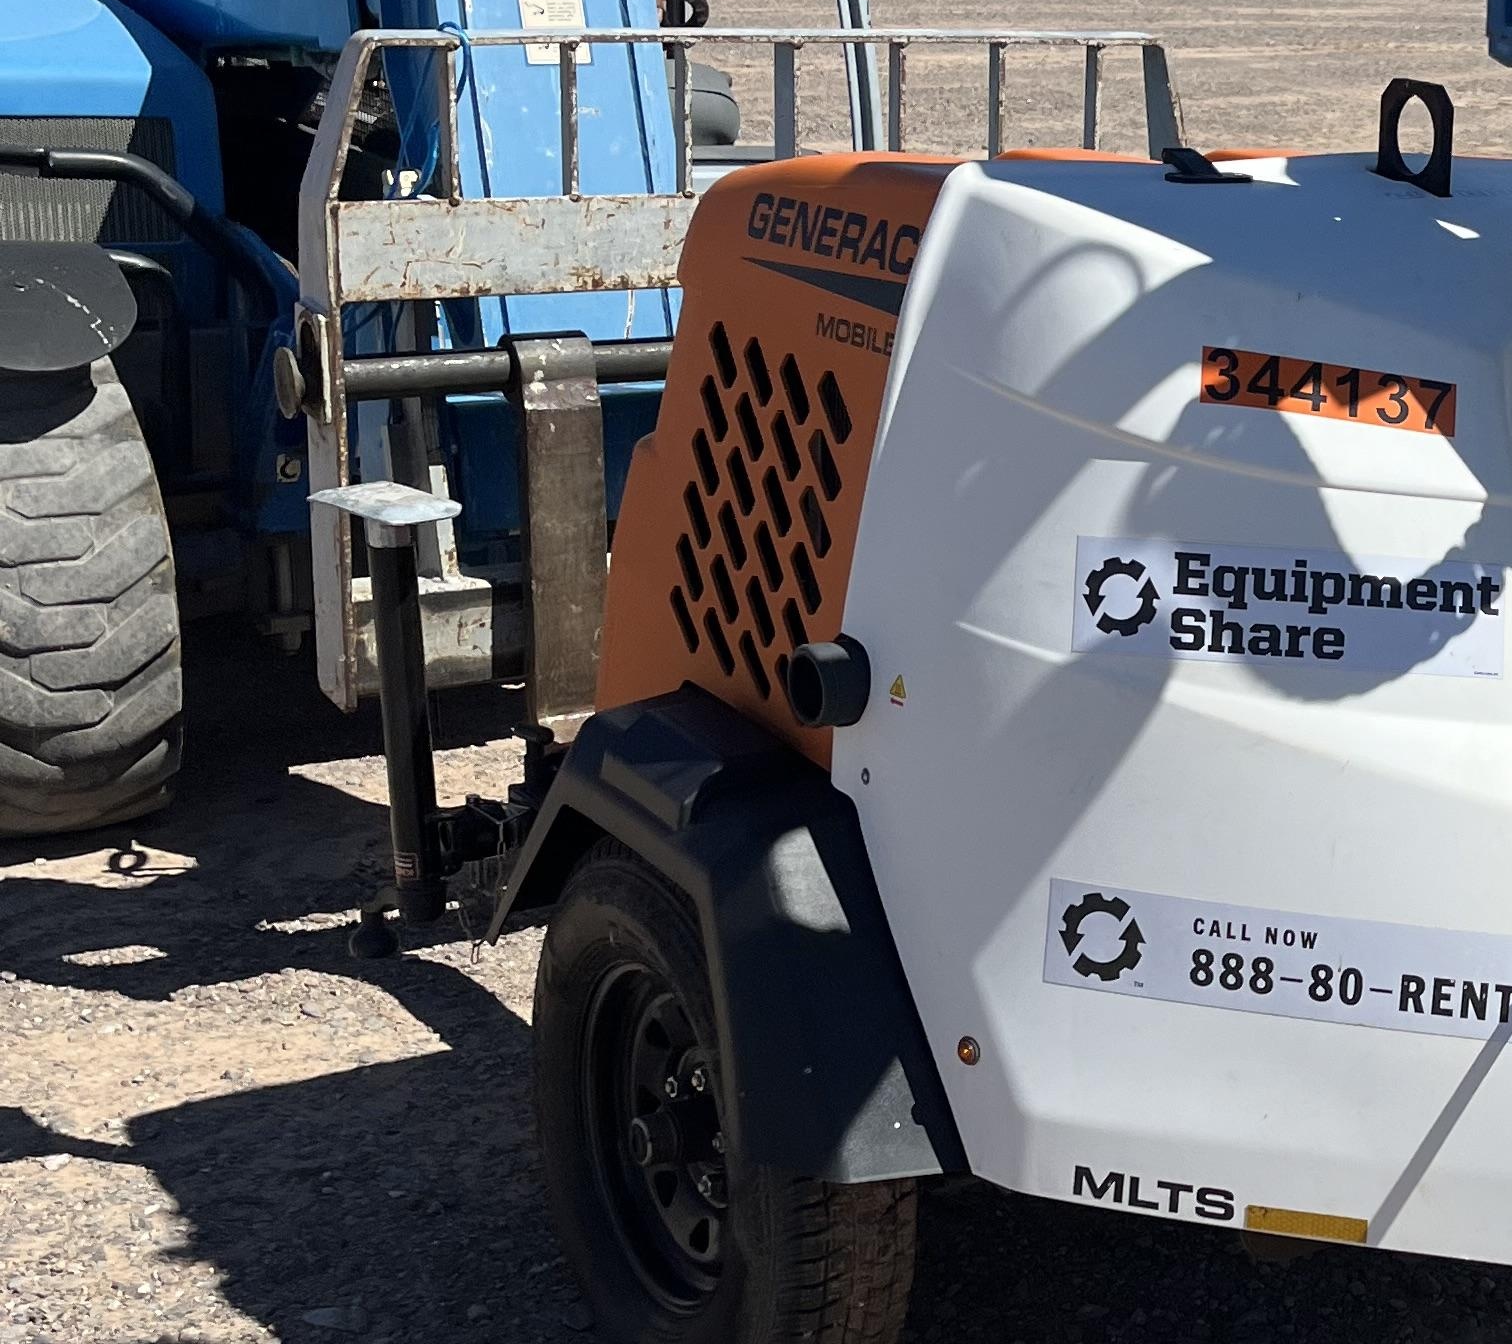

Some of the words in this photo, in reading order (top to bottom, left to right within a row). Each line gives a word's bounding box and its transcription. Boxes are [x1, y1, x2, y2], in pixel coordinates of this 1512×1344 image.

[748, 193, 923, 276] GENERAC
[816, 312, 896, 357] MOBILE
[1204, 348, 1451, 430] 344137
[1173, 552, 1500, 616] Equipment
[1169, 607, 1346, 660] Share
[1193, 917, 1251, 943] CALL
[1264, 929, 1319, 950] NOW
[1073, 1165, 1235, 1221] MLTS
